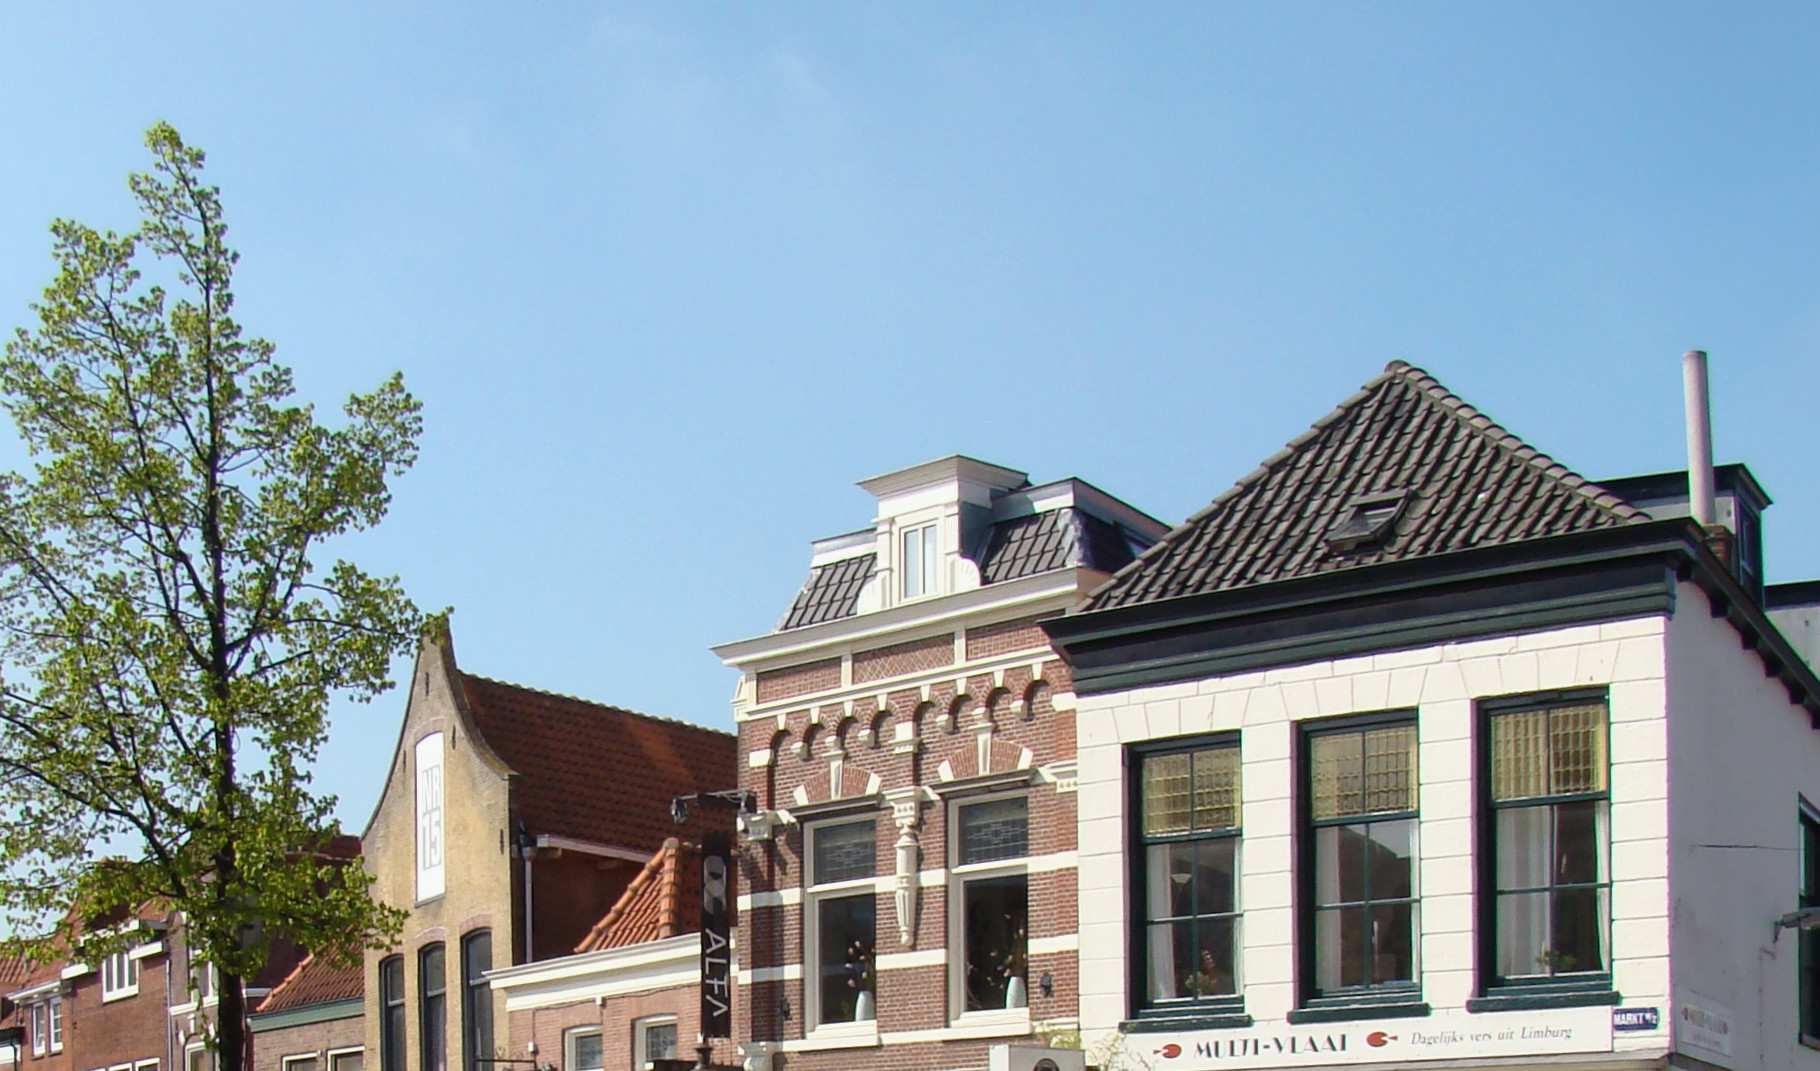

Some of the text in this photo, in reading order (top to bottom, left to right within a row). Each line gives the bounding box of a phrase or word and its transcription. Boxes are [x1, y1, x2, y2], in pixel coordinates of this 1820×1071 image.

[422, 764, 441, 814] NR
[423, 809, 442, 871] 15
[705, 927, 728, 1017] ALFA
[1411, 1026, 1573, 1046] Dagelijks vers uit Limburg
[1613, 1012, 1643, 1026] MARKT
